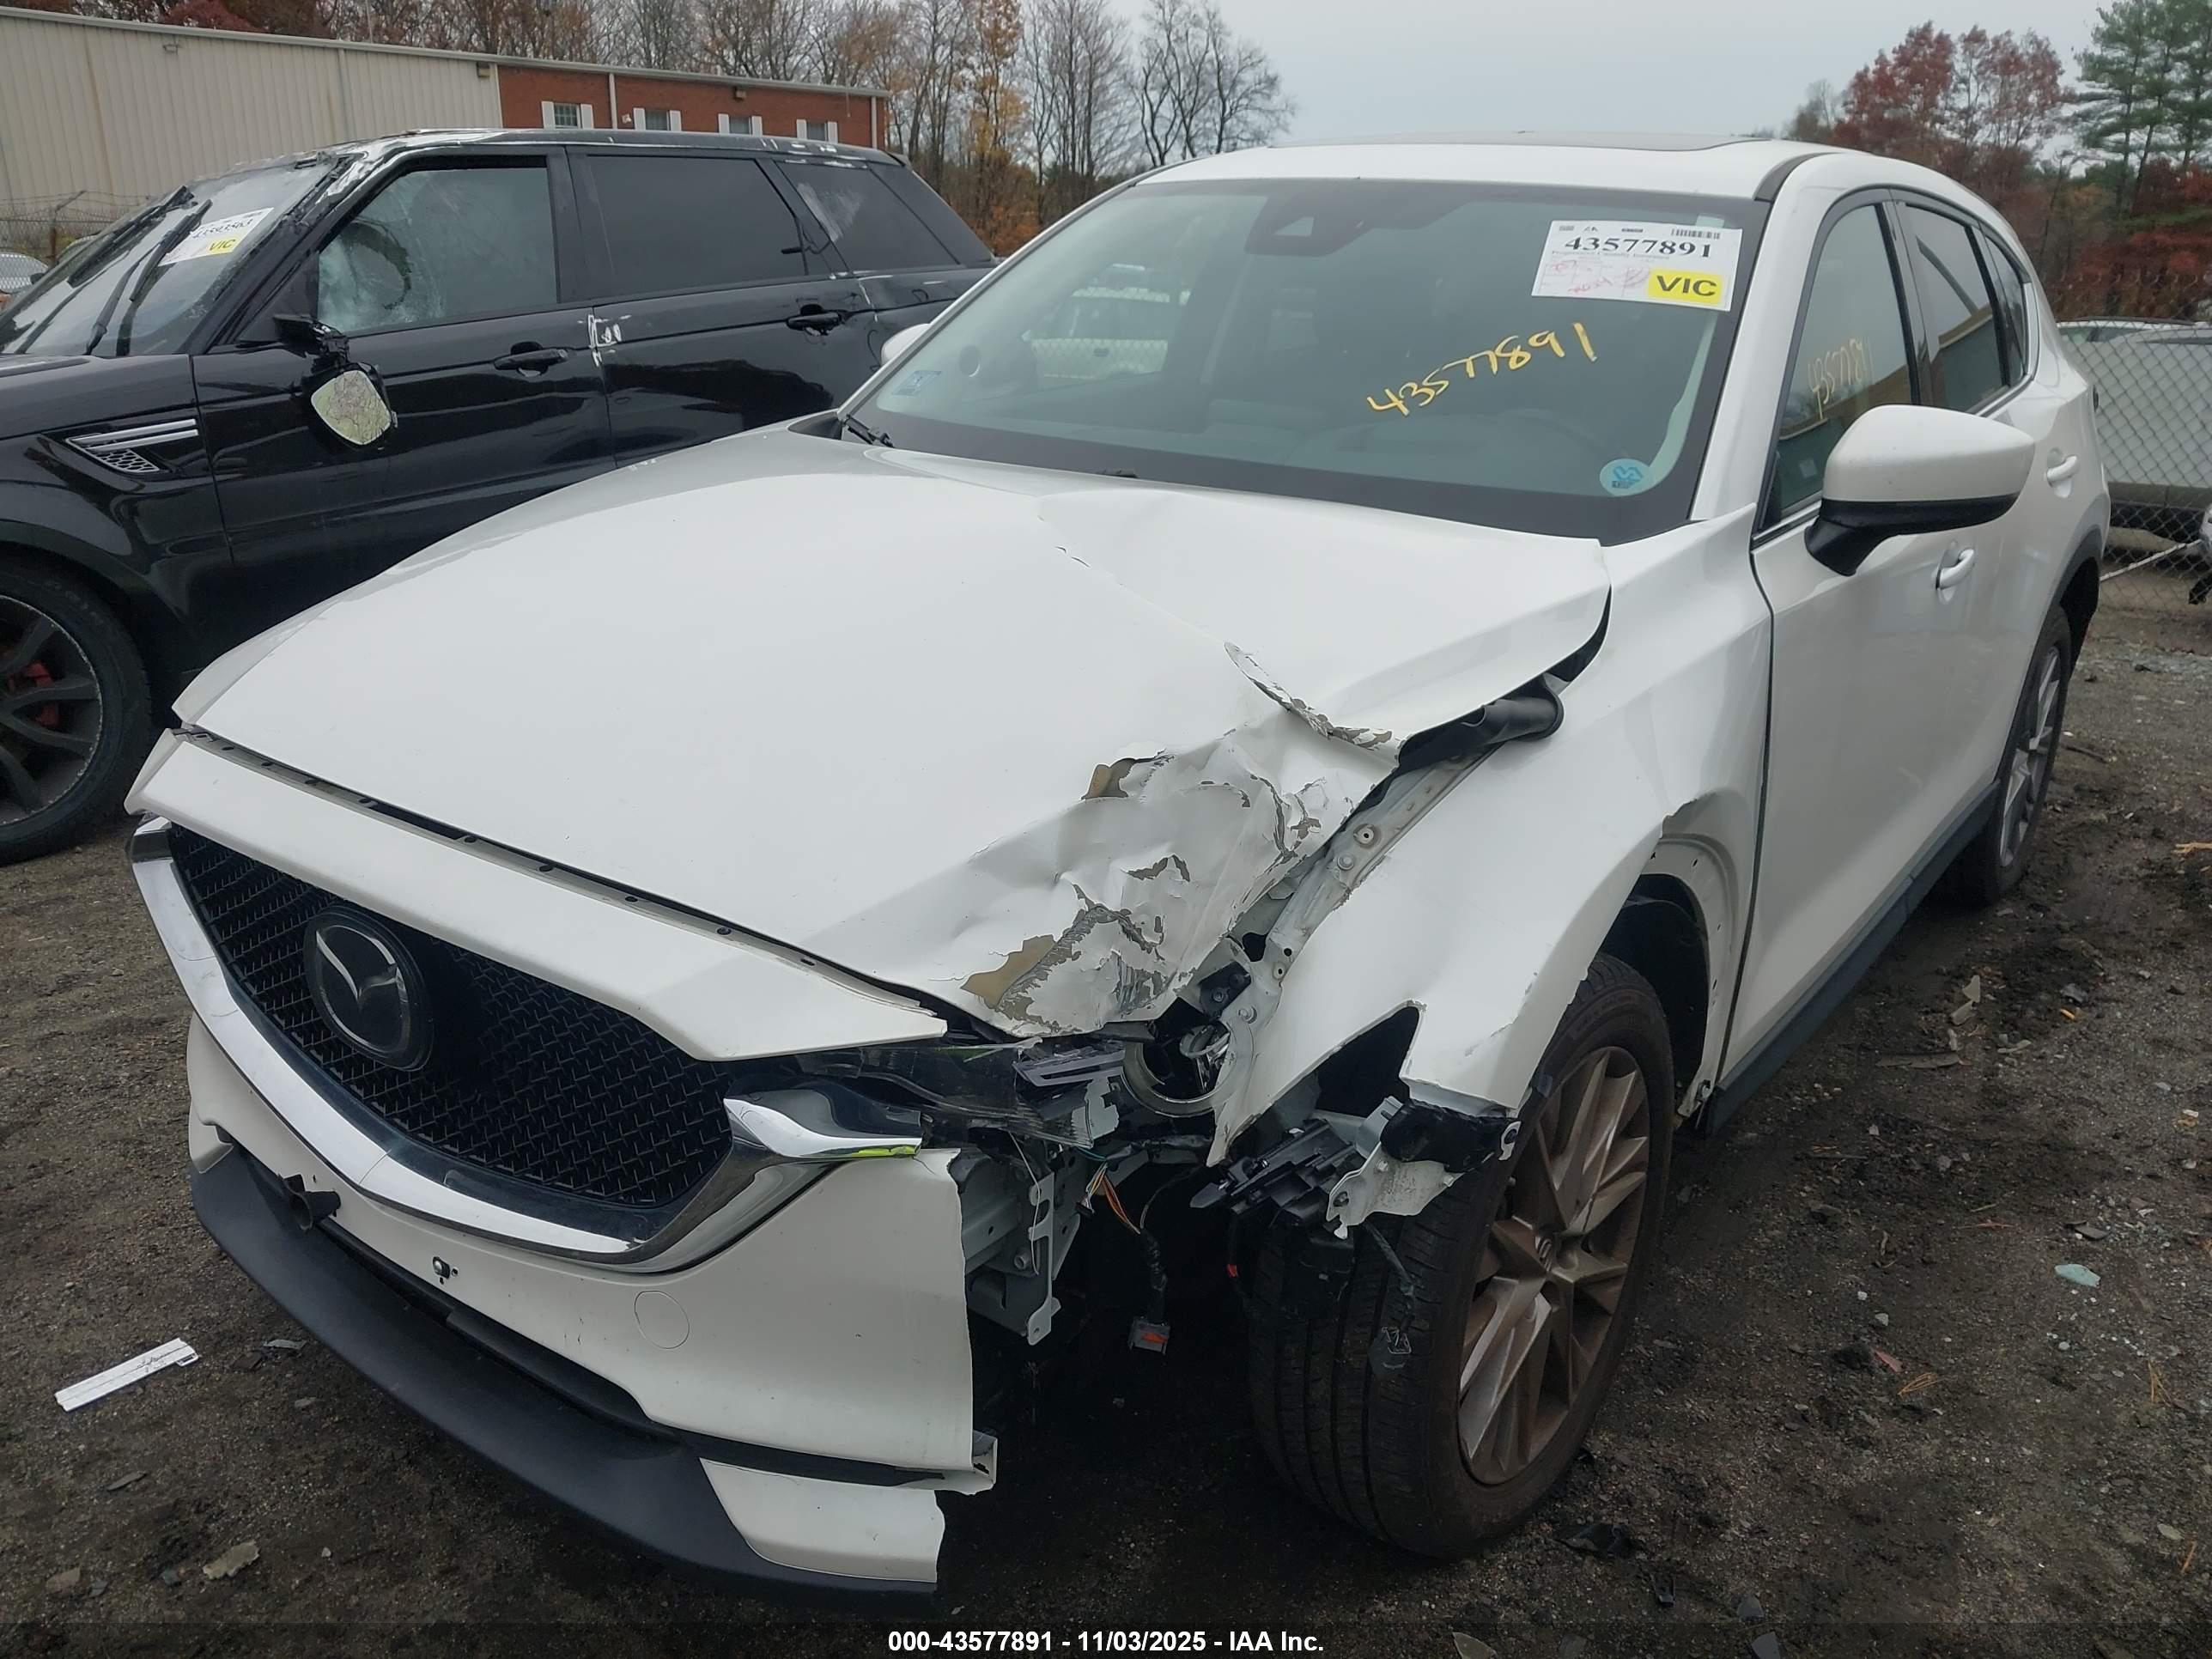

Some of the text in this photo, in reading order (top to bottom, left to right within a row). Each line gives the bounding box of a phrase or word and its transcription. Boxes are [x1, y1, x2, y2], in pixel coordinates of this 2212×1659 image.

[209, 239, 236, 251] VIC
[1565, 235, 1711, 258] 43577891
[1656, 275, 1717, 297] VIC
[1367, 322, 1597, 416] 43577891
